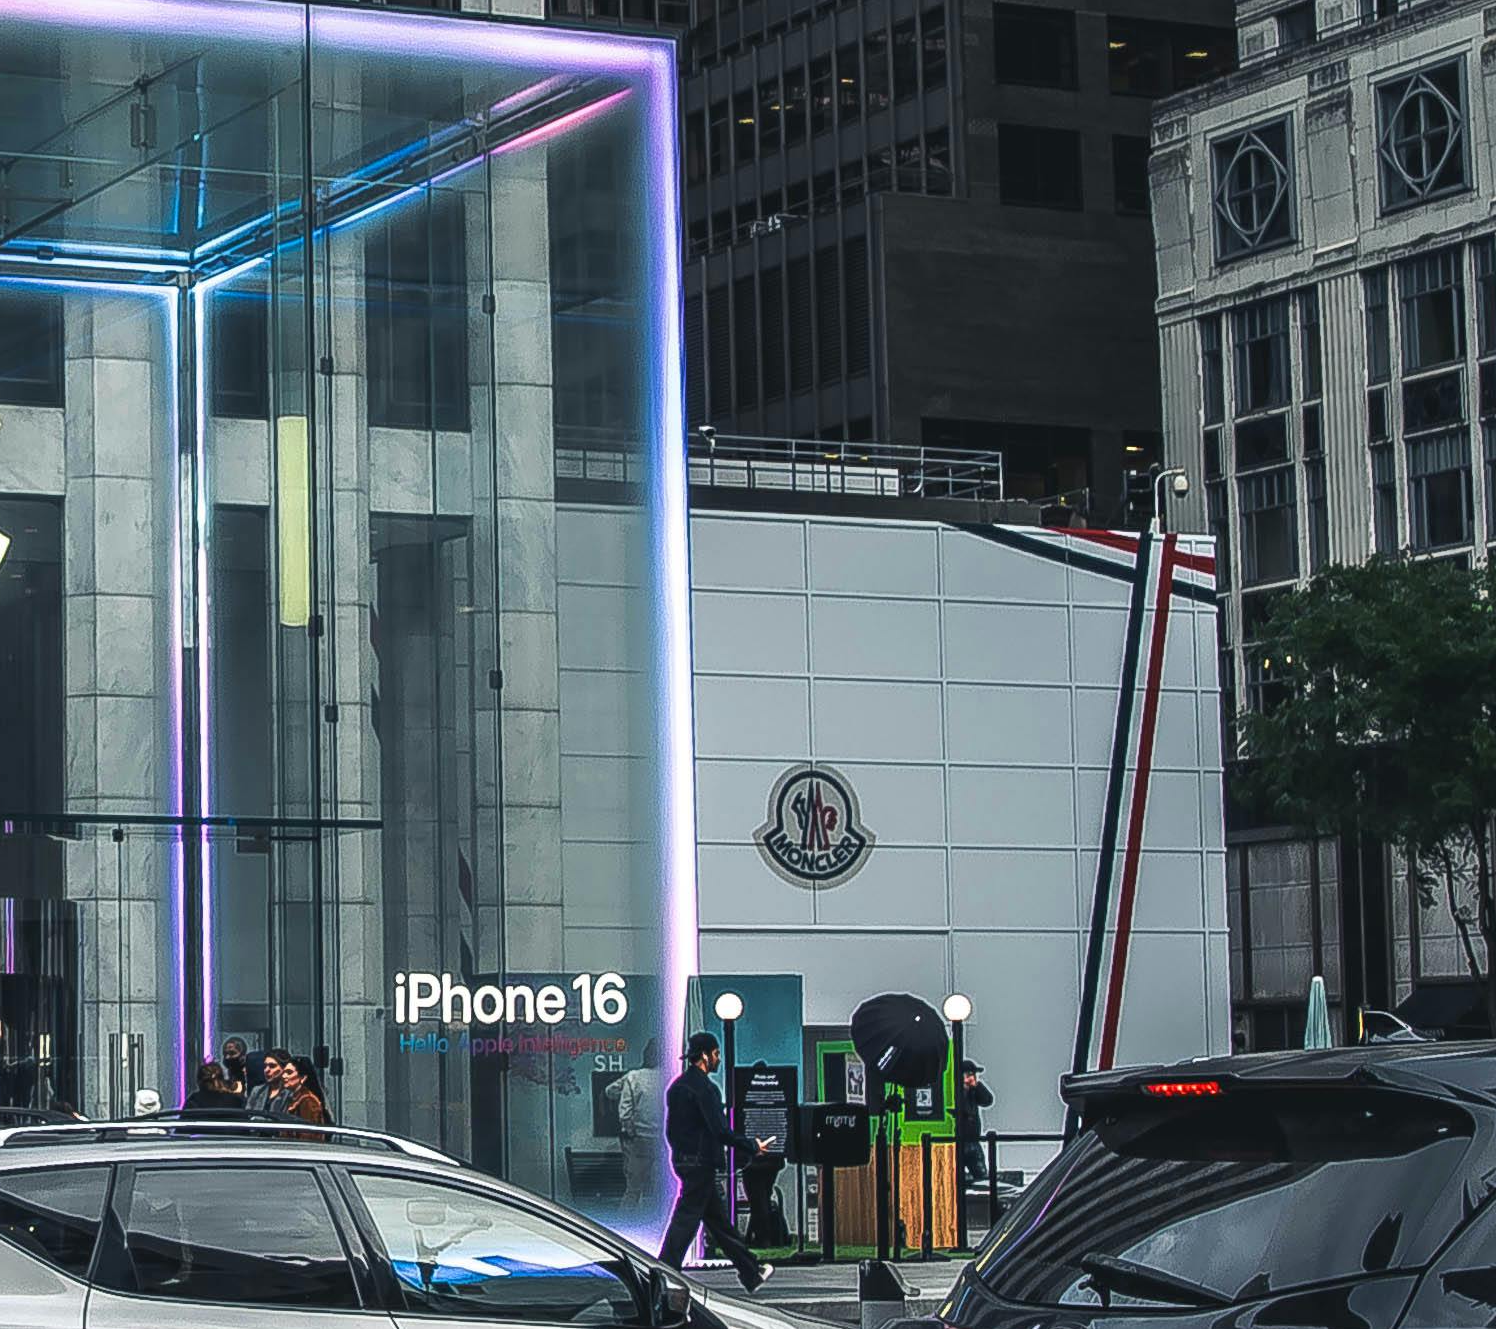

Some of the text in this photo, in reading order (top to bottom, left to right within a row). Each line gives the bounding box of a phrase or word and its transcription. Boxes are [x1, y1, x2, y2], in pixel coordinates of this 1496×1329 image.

[772, 832, 858, 872] MONCLER
[395, 972, 628, 1024] iPhone 16
[458, 1032, 513, 1056] Apple
